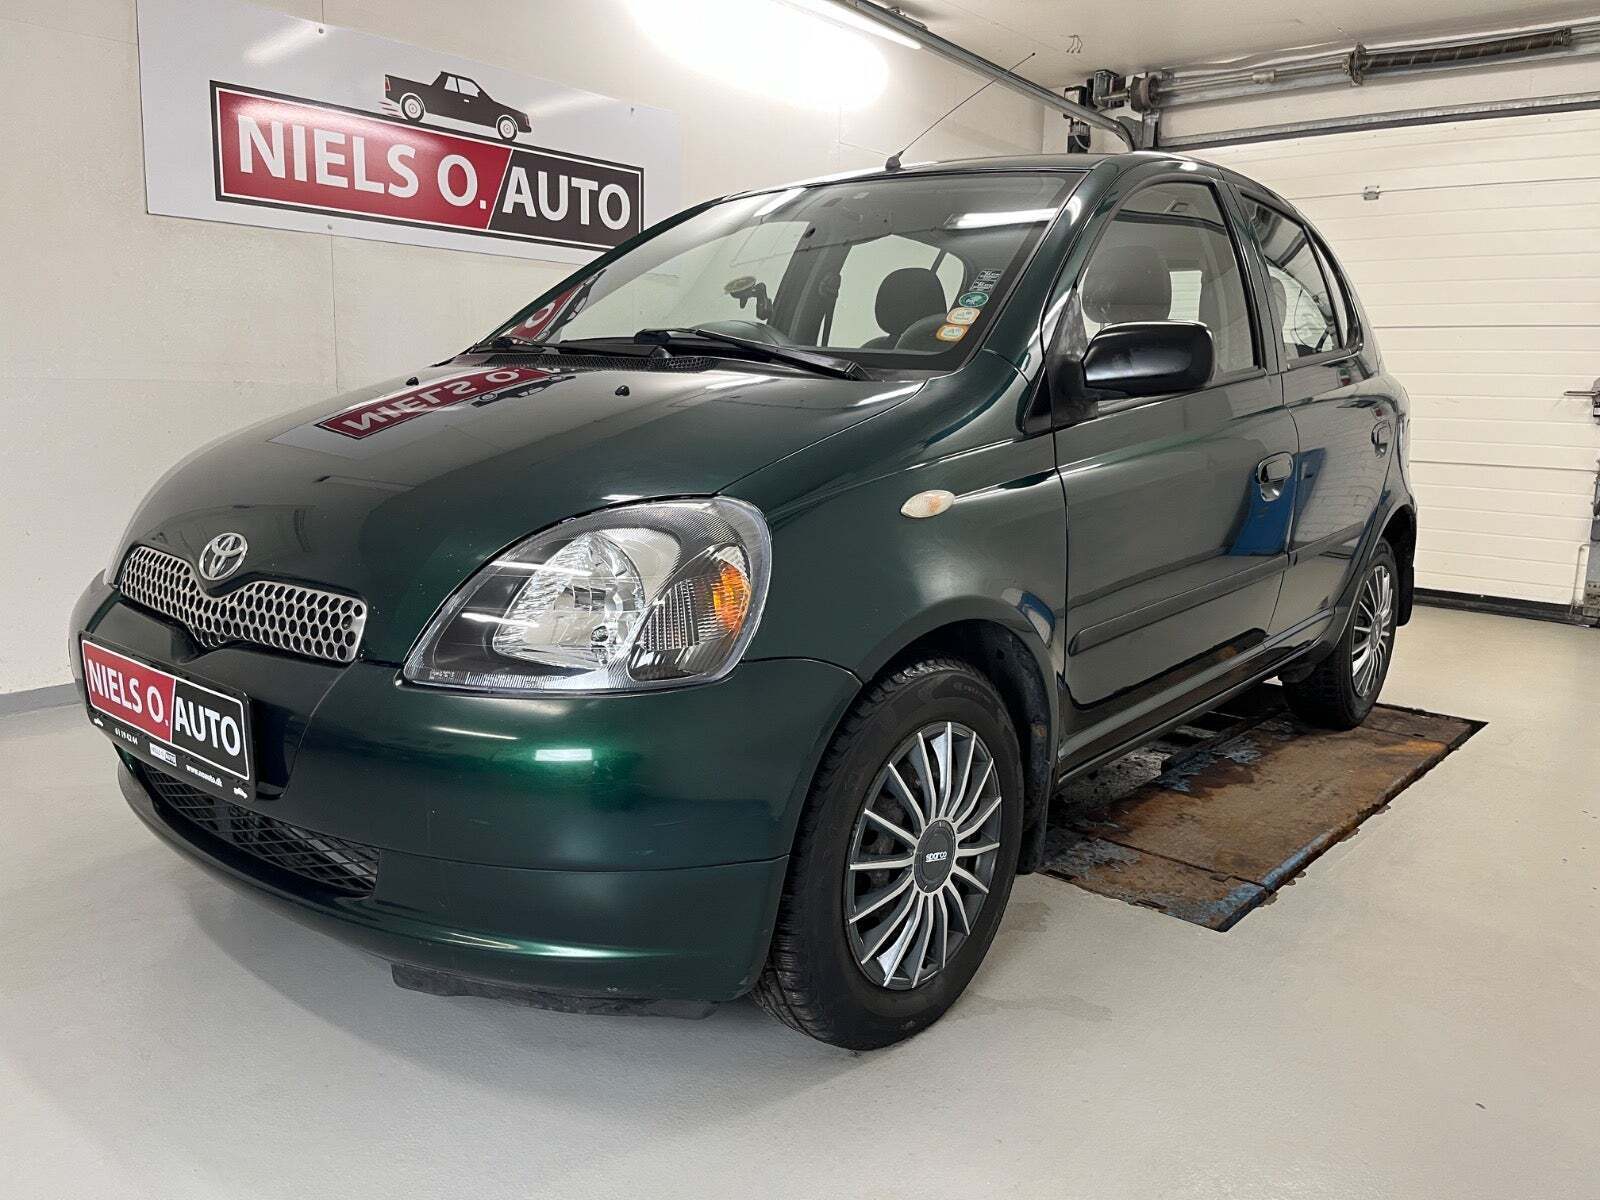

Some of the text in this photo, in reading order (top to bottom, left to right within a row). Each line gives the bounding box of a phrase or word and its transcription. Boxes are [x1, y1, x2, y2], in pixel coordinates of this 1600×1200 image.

[238, 115, 631, 231] NIELS O. AUTO
[88, 659, 143, 714] NIELS
[147, 686, 169, 726] O.
[175, 696, 241, 756] AUTO
[925, 850, 947, 862] sparco
